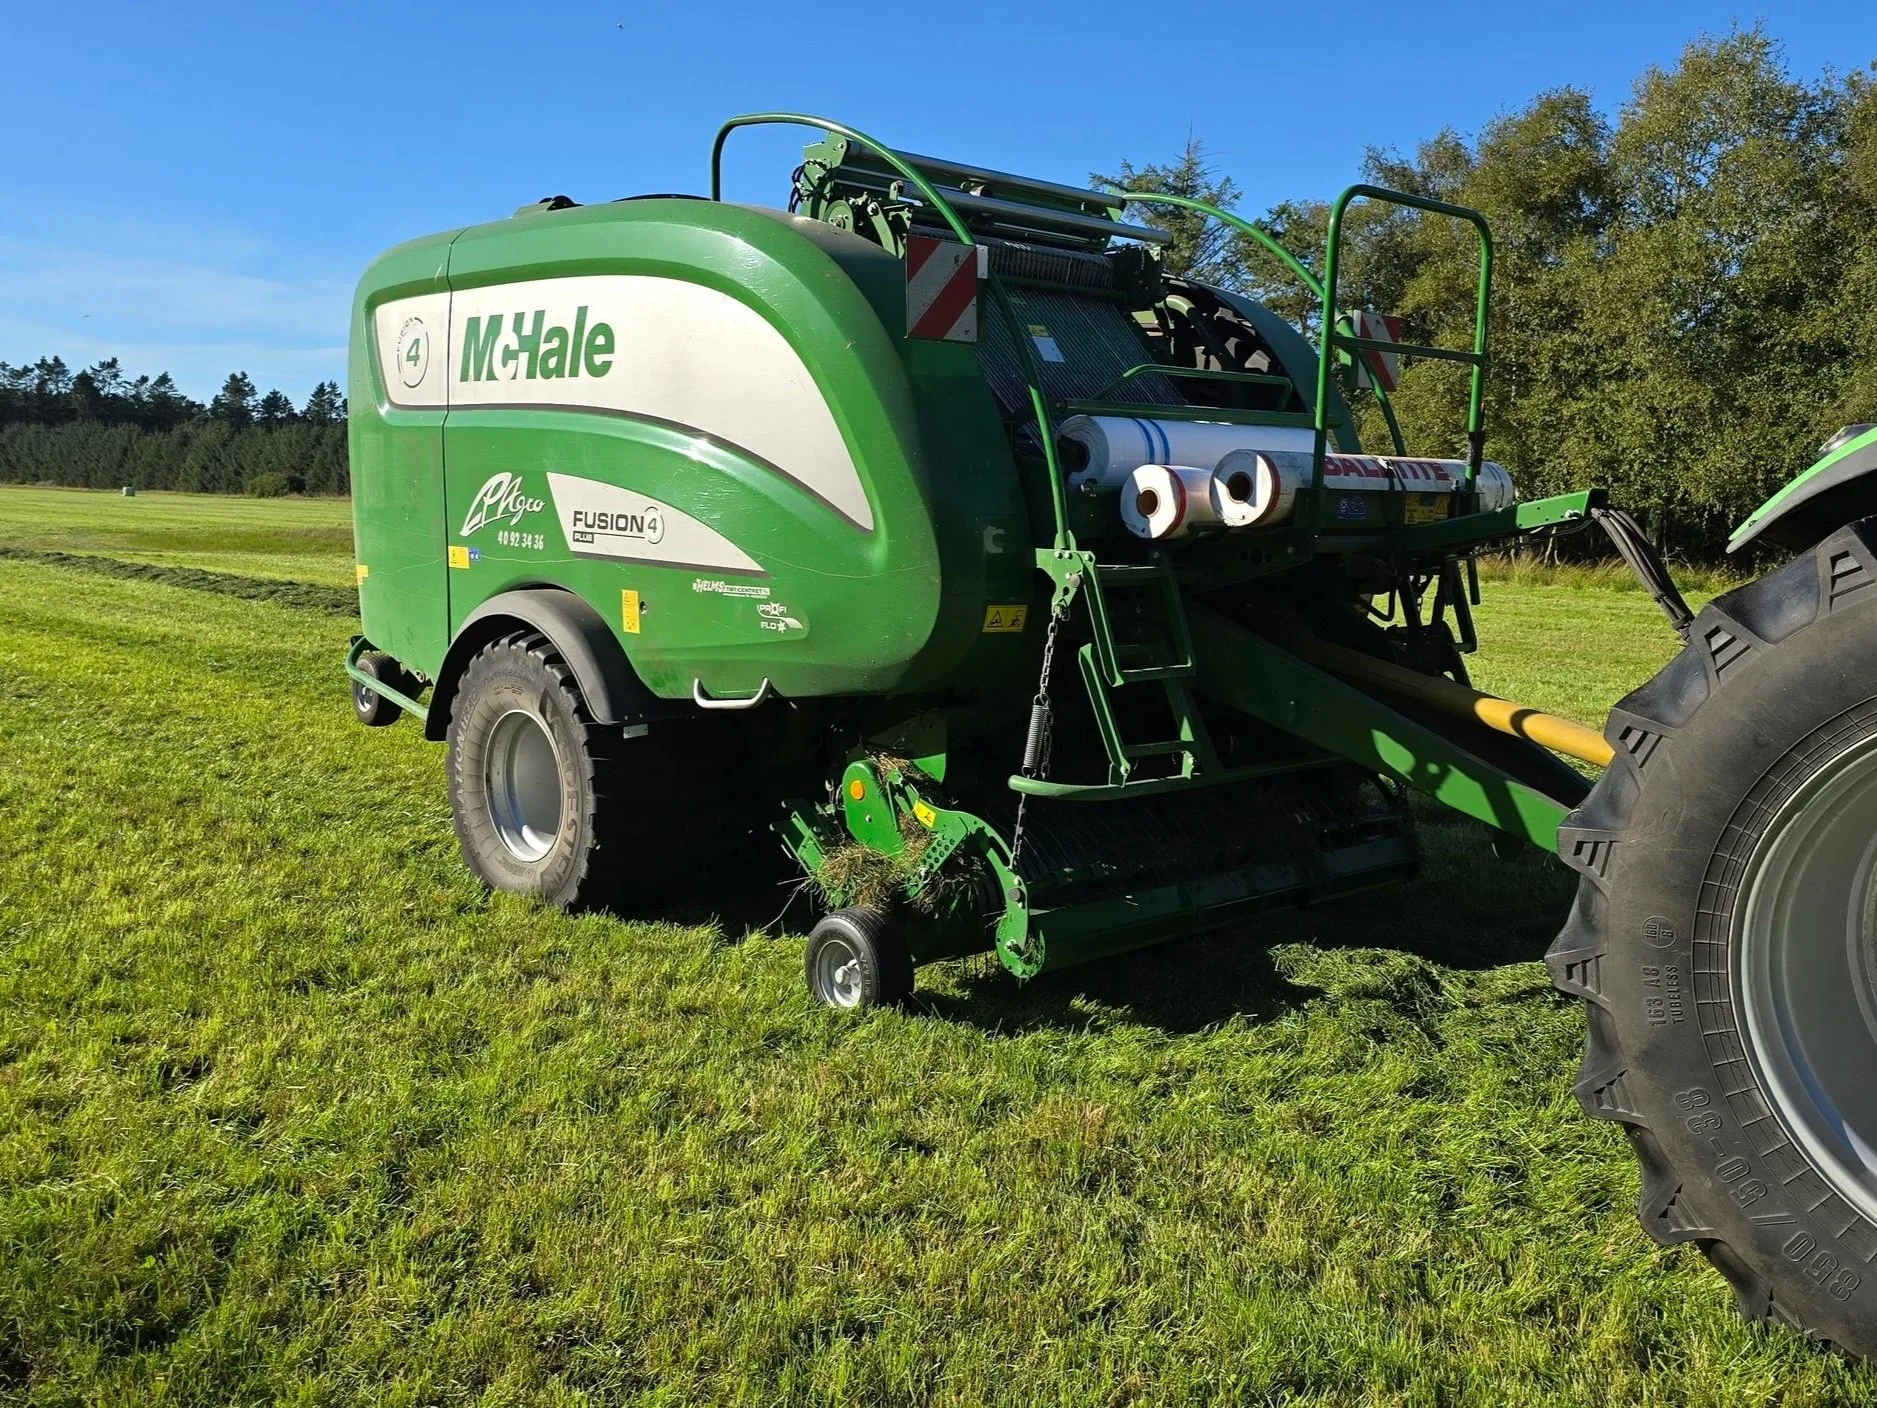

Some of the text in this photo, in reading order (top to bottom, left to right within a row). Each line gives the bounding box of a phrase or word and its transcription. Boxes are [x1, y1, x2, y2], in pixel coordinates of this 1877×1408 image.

[406, 338, 420, 367] 4
[460, 306, 615, 382] McHale
[573, 510, 658, 534] FUSION 4
[497, 530, 544, 551] 40 92 34 36
[575, 532, 593, 542] PLUS
[760, 602, 788, 616] PROFI
[1645, 923, 1658, 939] 160
[1641, 965, 1667, 1027] 163 A8
[1664, 964, 1685, 1025] TUBELESS
[1674, 1087, 1861, 1301] 850/50-38
